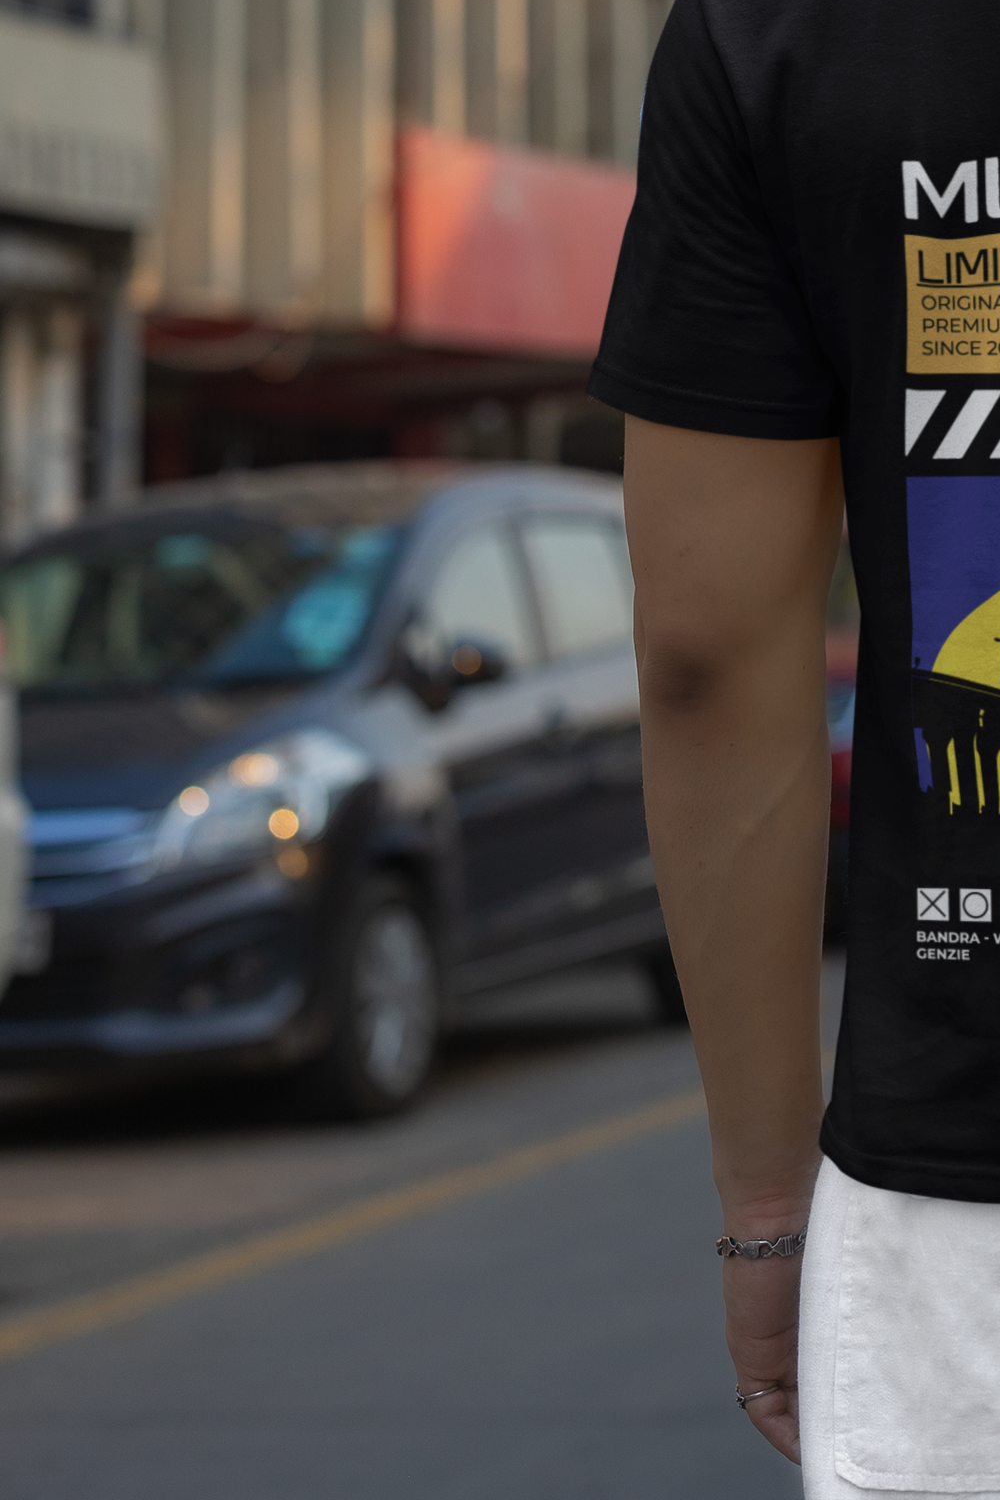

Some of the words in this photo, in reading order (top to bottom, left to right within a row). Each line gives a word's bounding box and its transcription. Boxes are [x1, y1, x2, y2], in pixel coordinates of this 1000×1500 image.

[922, 340, 982, 356] SINCE
[916, 930, 981, 944] BANDRA
[916, 947, 971, 961] GENZIE
